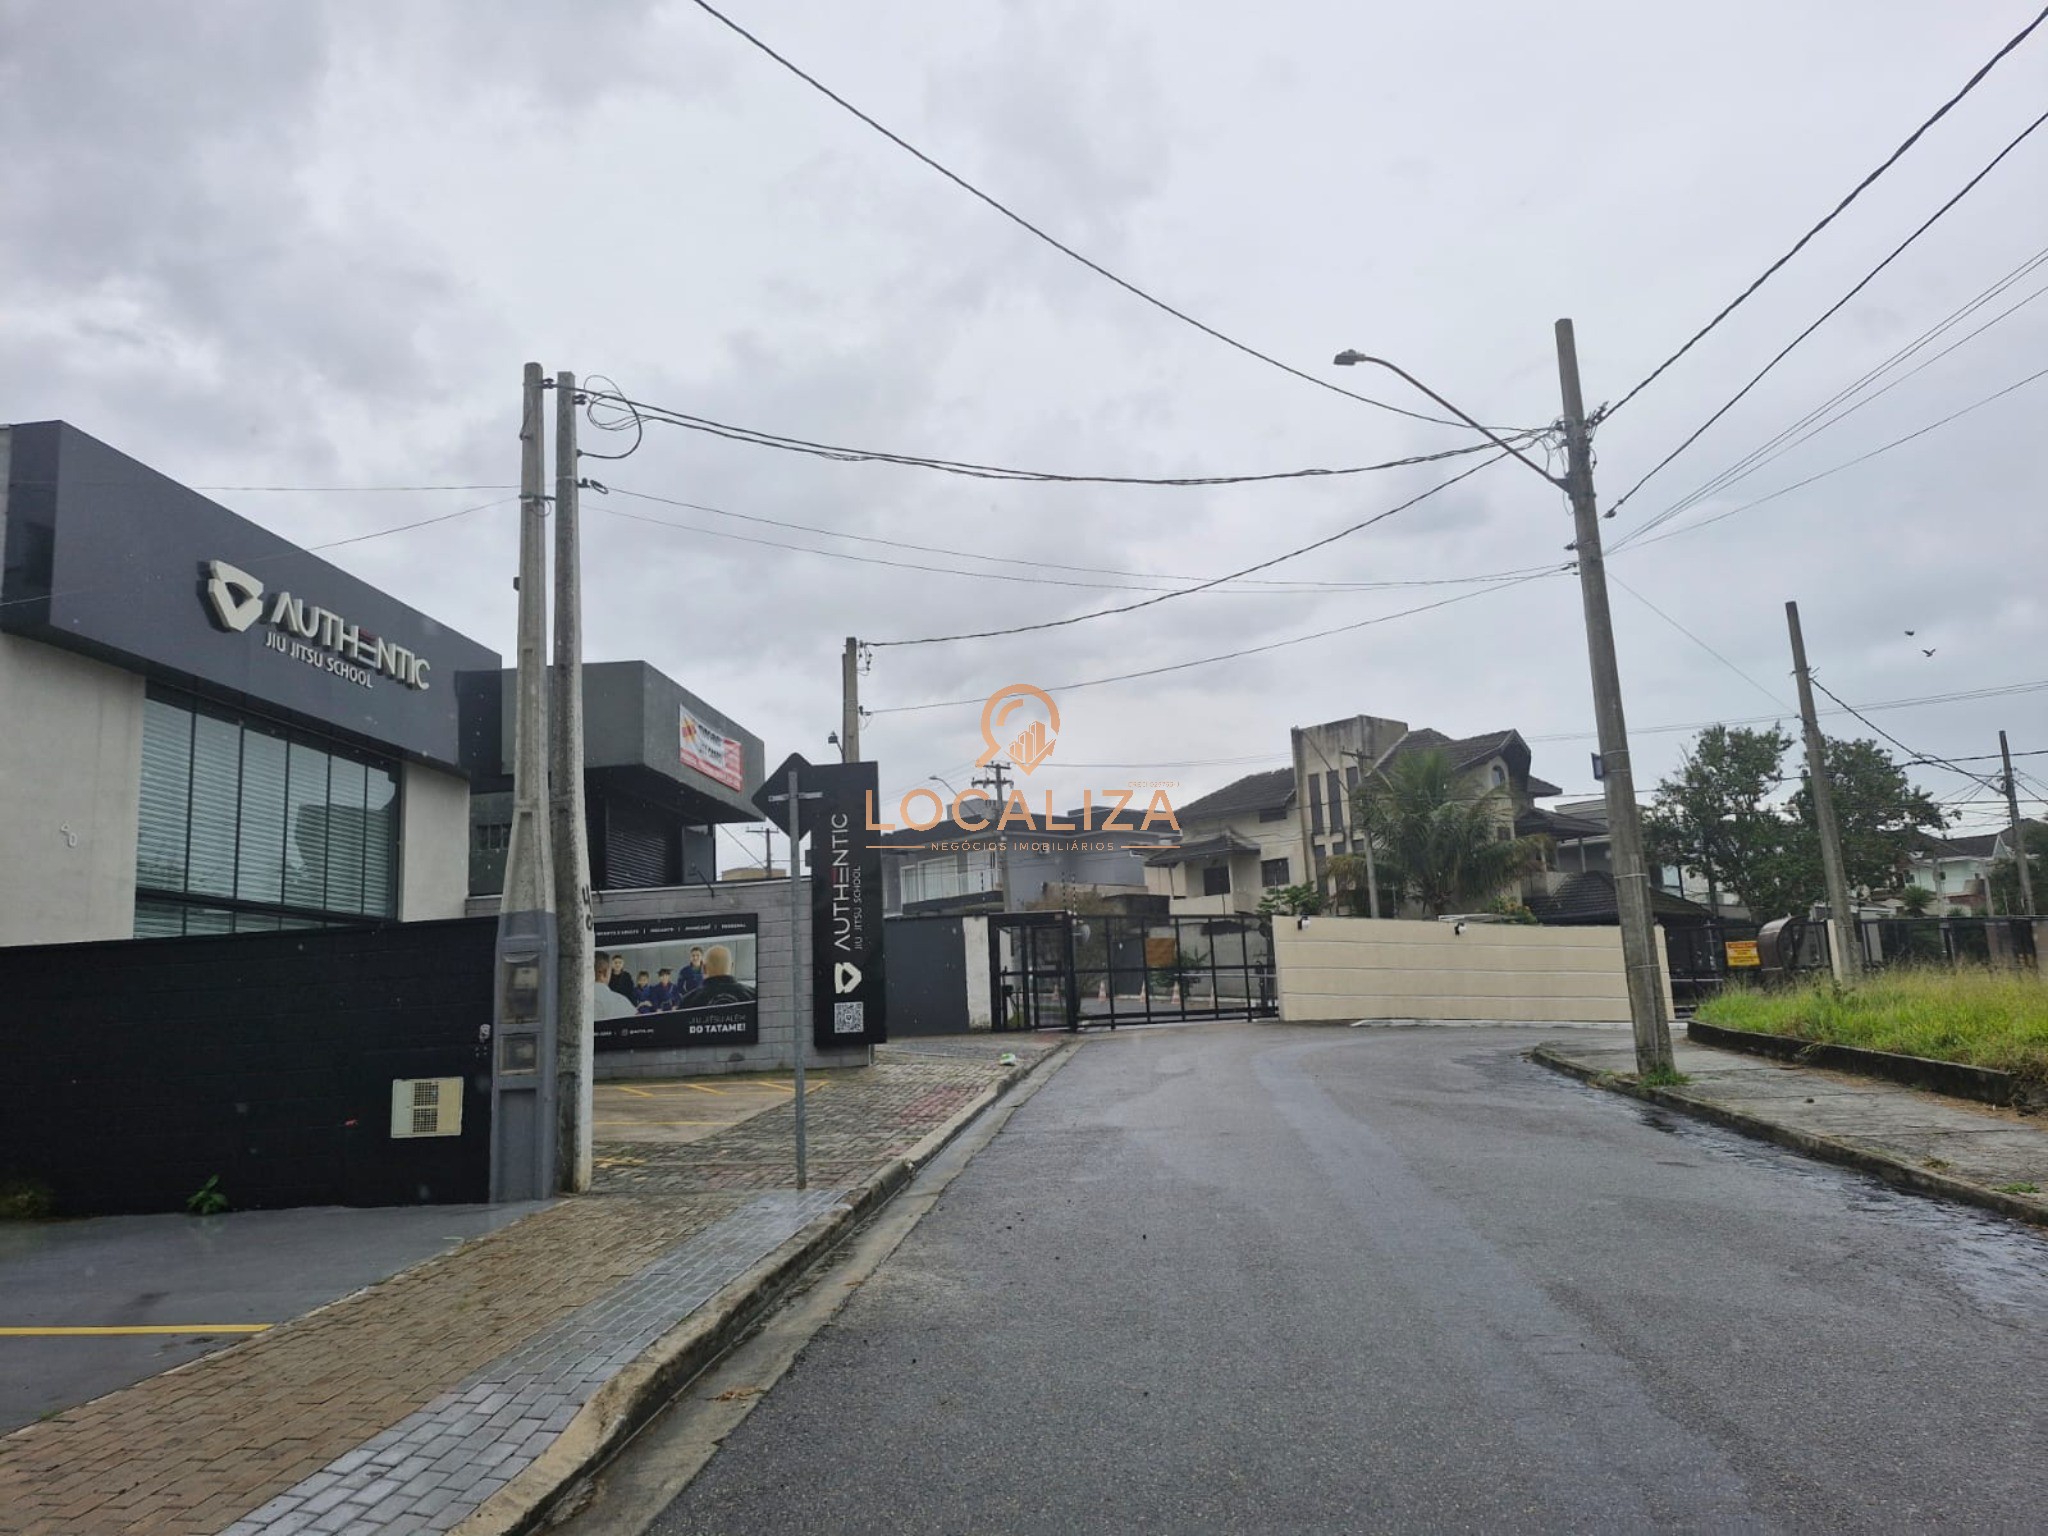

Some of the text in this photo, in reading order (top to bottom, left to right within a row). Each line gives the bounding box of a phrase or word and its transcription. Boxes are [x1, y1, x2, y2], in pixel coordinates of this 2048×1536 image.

[266, 632, 374, 688] JIU JITSU SCHOOL
[271, 592, 431, 690] AUTHENTIC
[832, 814, 850, 951] AUTHENTIC
[852, 865, 862, 904] SCHOOL
